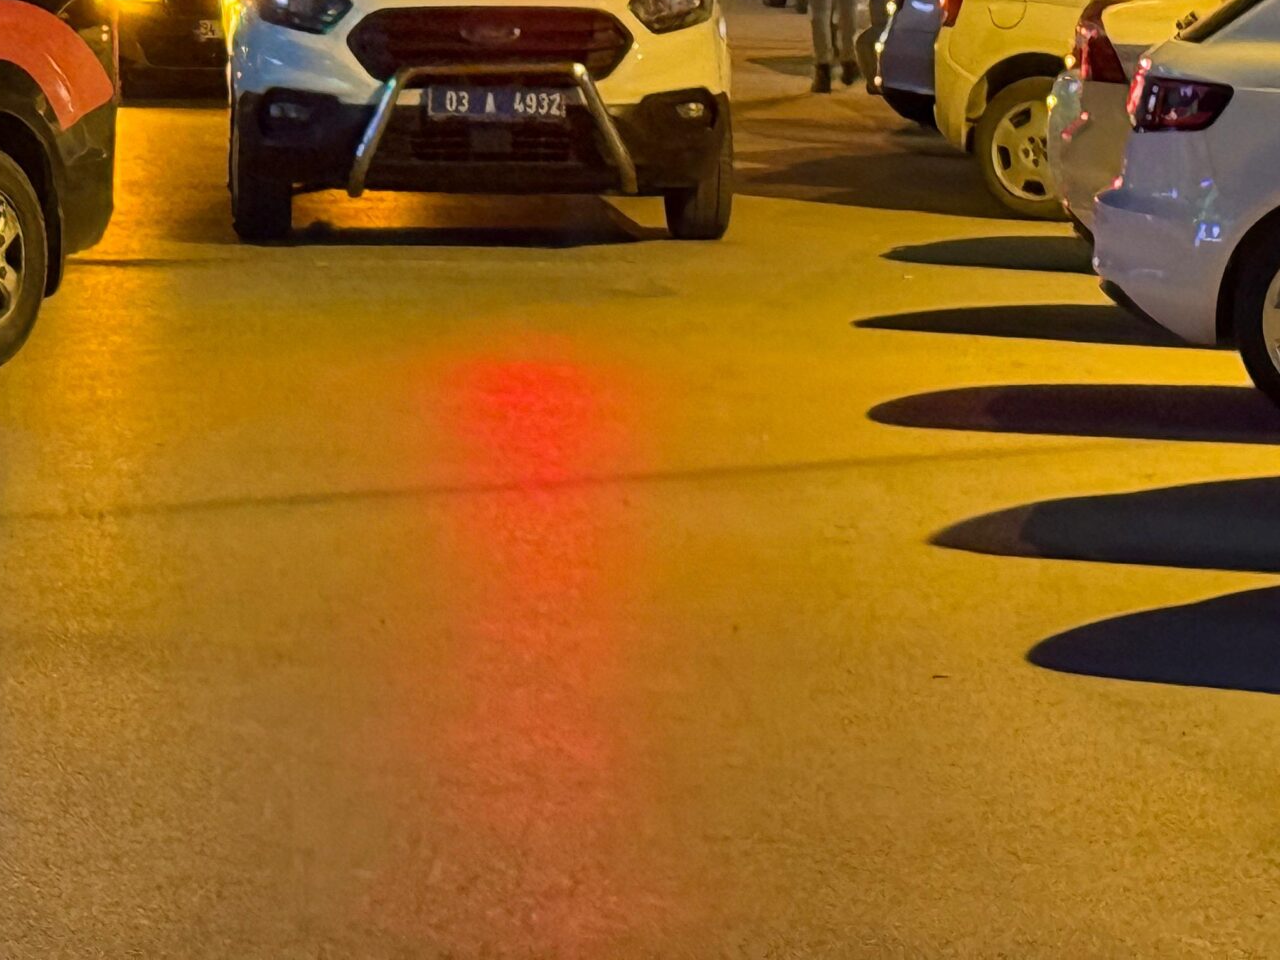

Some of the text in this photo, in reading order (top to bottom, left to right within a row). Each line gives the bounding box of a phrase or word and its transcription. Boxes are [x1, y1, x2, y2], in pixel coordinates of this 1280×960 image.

[446, 90, 560, 117] 03 A 4932
